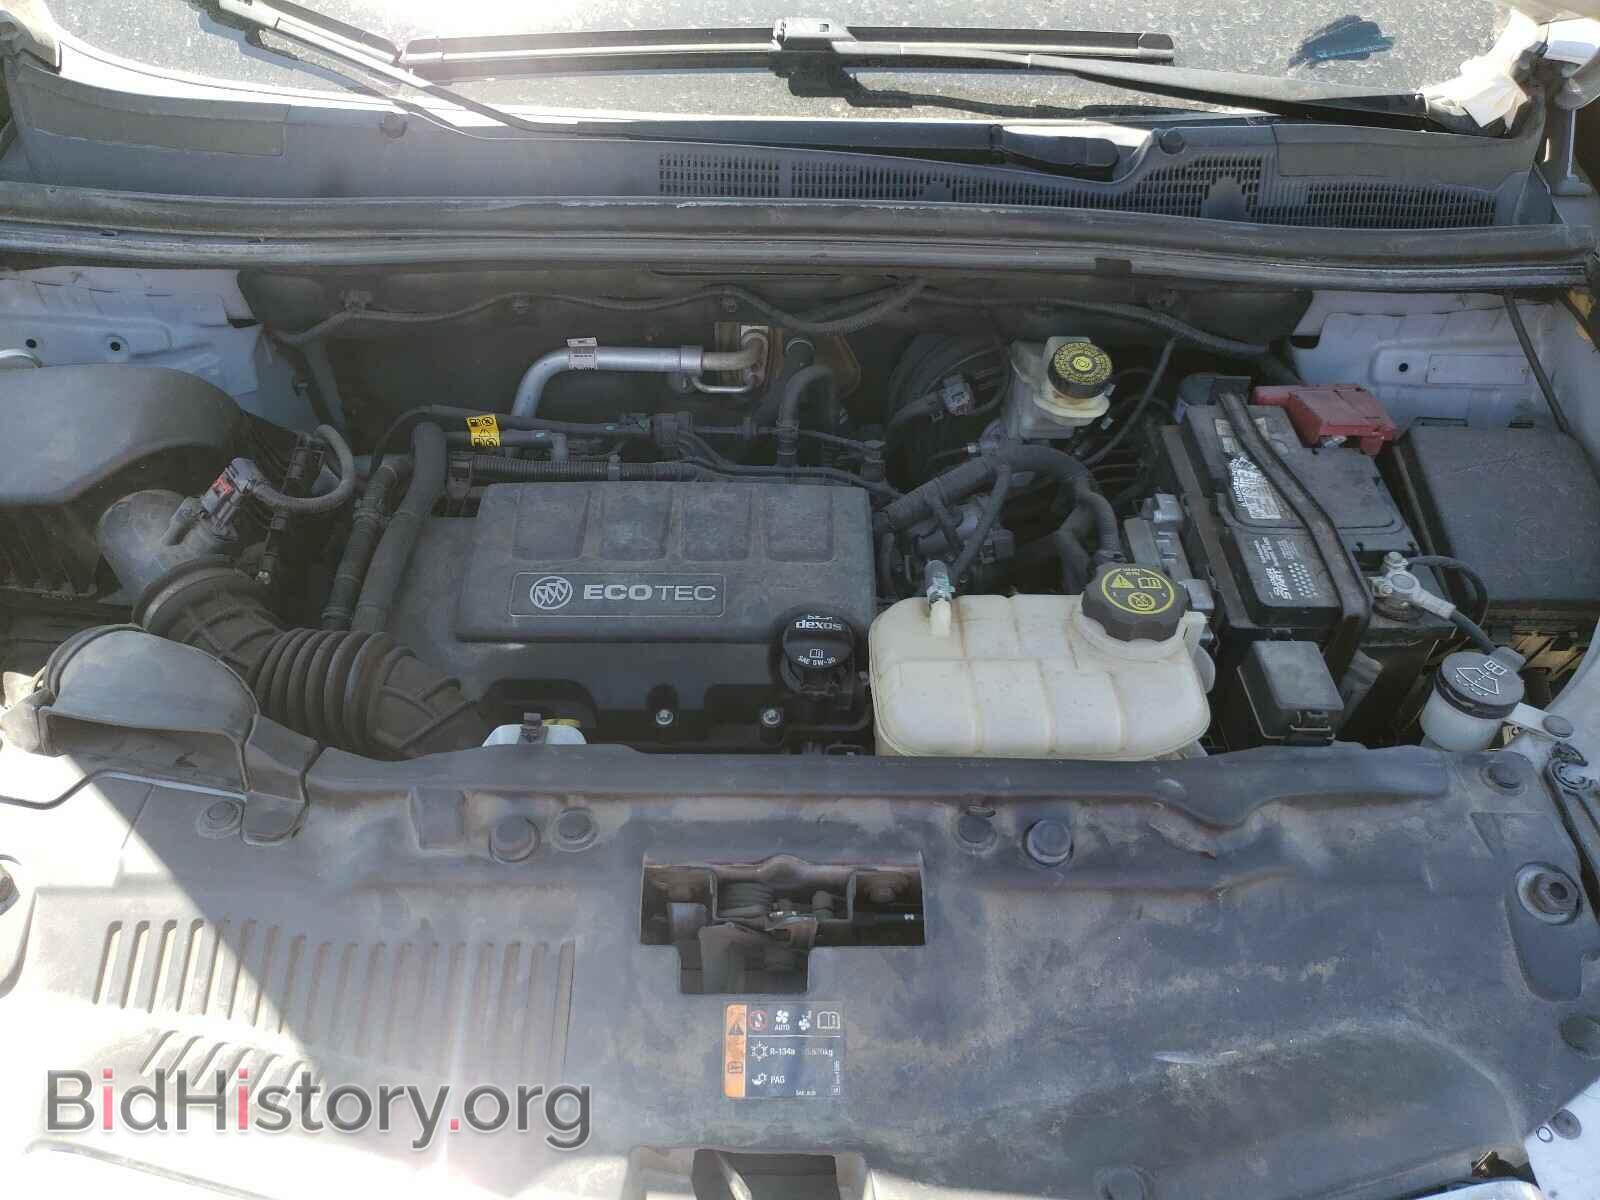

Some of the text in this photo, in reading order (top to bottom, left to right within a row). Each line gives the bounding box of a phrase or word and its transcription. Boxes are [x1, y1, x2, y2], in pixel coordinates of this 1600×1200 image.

[583, 584, 717, 601] ECOTEC
[795, 620, 842, 631] dexos
[769, 1047, 796, 1056] R-134a
[770, 1075, 785, 1085] PAG
